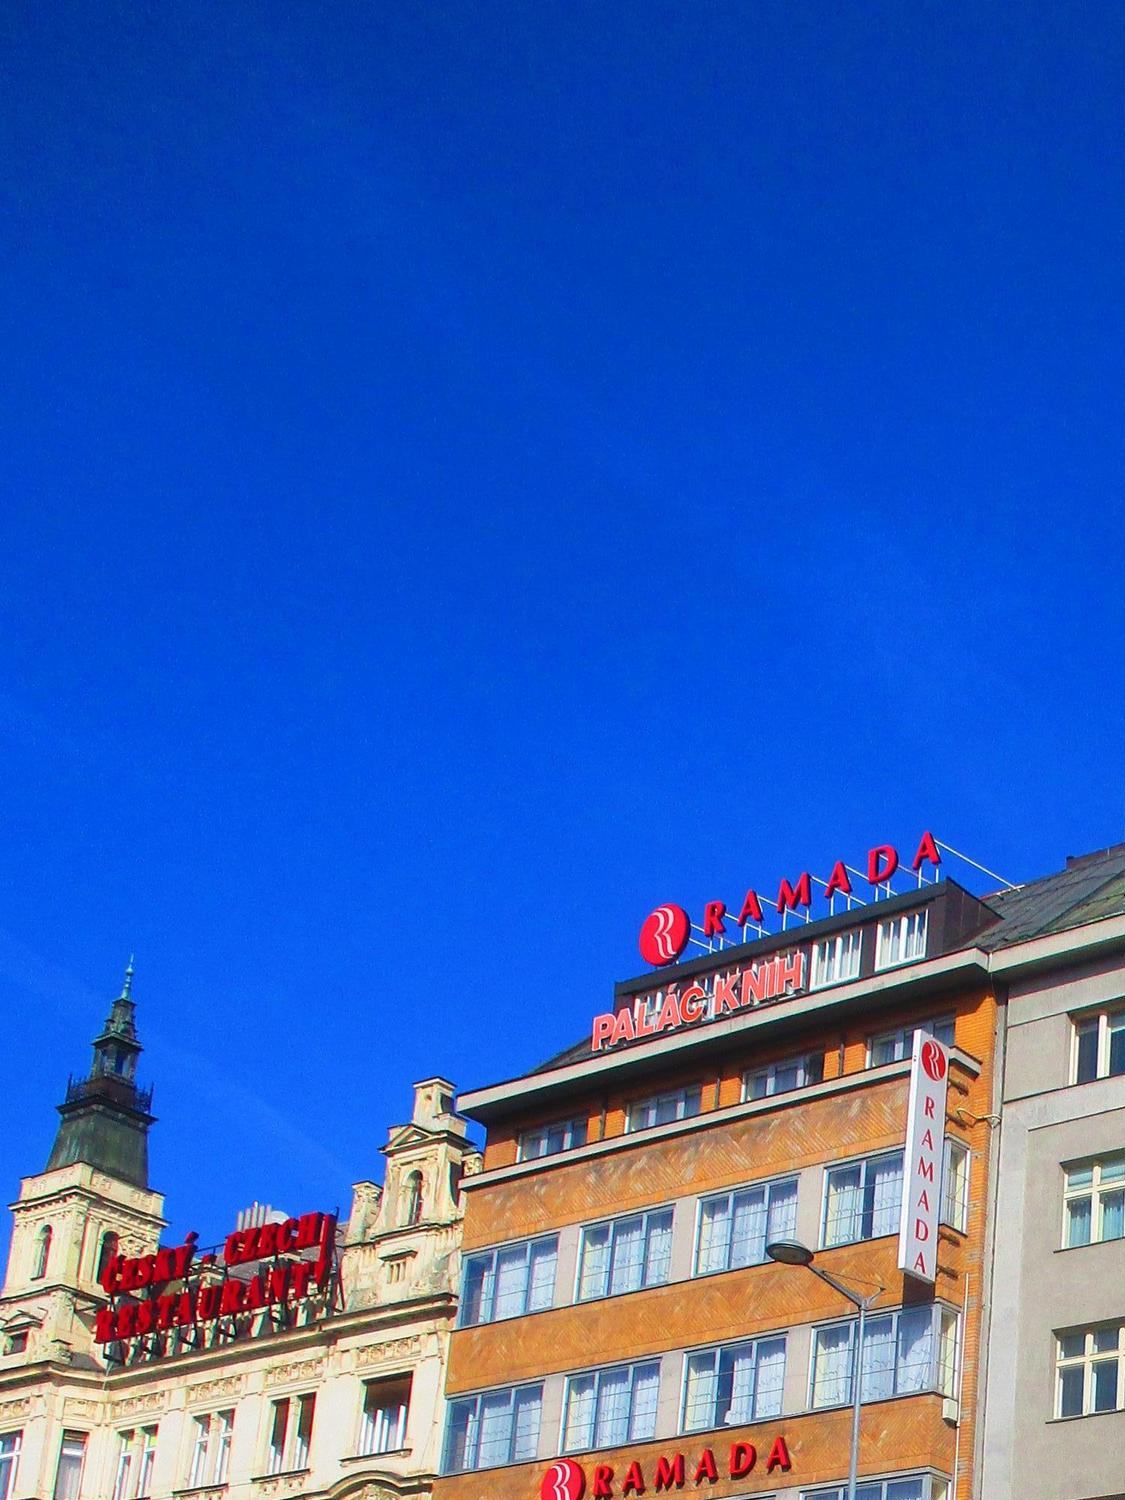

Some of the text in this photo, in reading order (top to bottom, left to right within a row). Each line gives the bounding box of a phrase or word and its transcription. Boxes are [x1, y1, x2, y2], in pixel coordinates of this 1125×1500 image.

[704, 831, 941, 937] RAMADA
[591, 953, 805, 1051] PALÁC KNIH
[914, 1095, 936, 1275] RAMADA
[224, 1212, 324, 1265] CZECH
[593, 1435, 792, 1500] RAMADA
